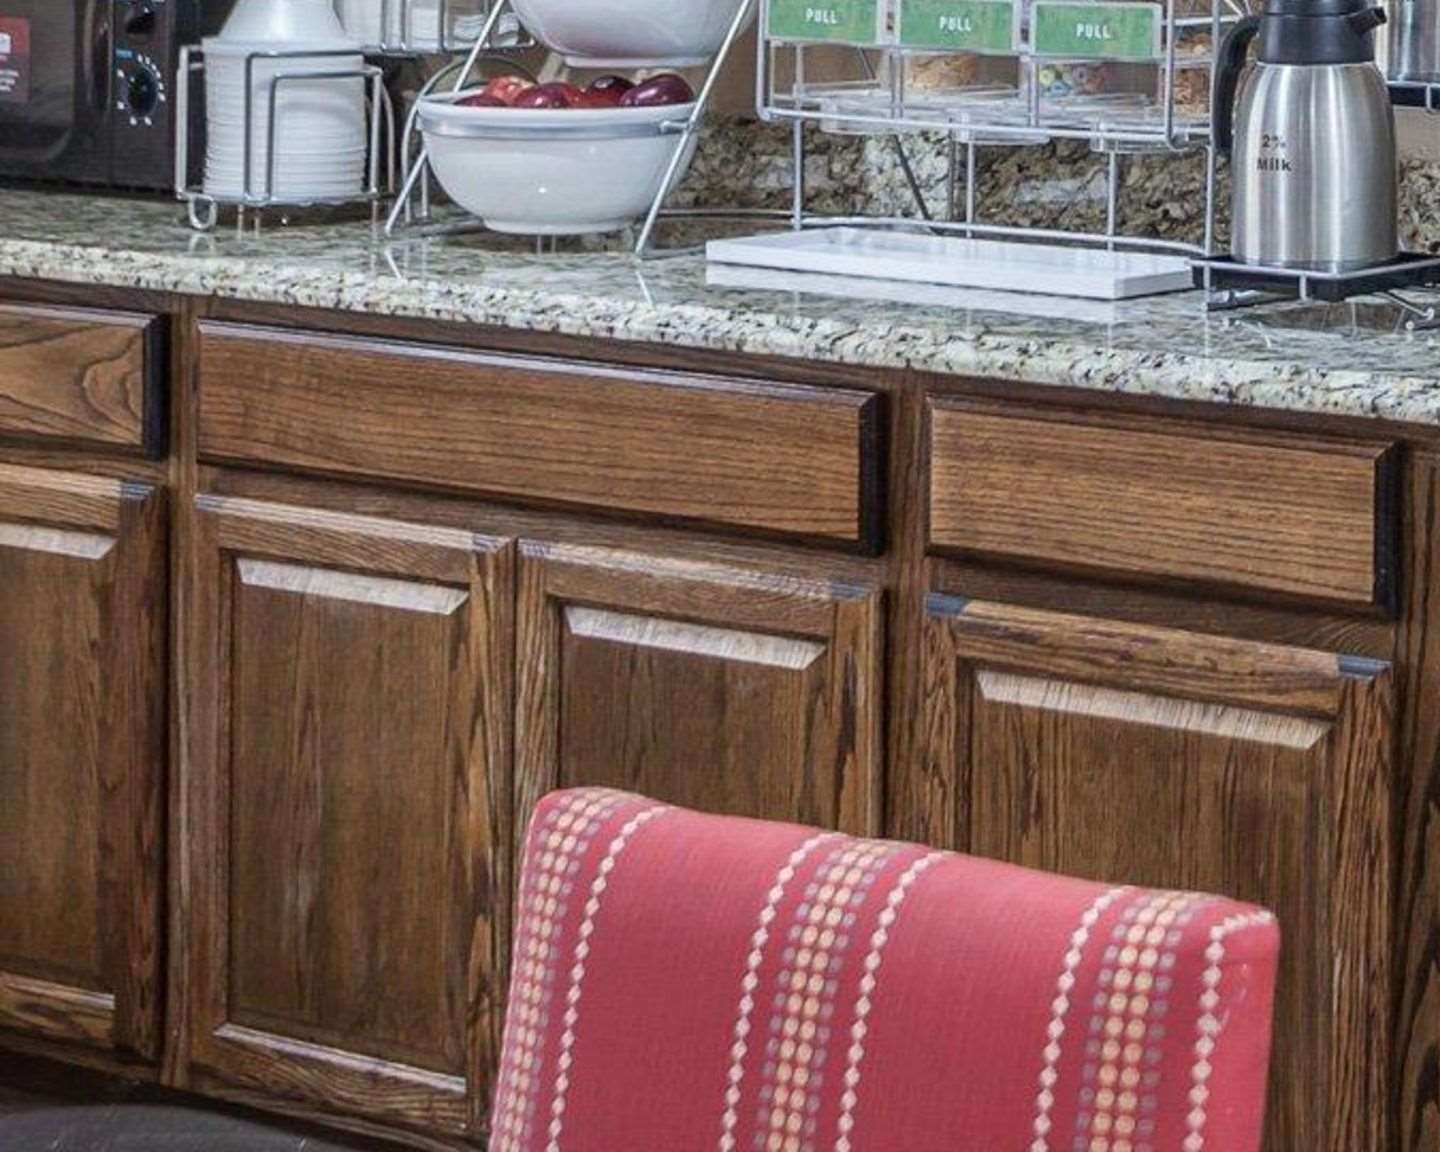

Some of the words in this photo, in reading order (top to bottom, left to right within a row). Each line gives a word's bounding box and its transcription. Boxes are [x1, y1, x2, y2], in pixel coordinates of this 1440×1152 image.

[805, 7, 838, 25] PULL
[939, 15, 972, 33] PULL
[1075, 22, 1112, 40] PULL
[1261, 134, 1287, 150] 2%
[1257, 156, 1292, 172] Milk
